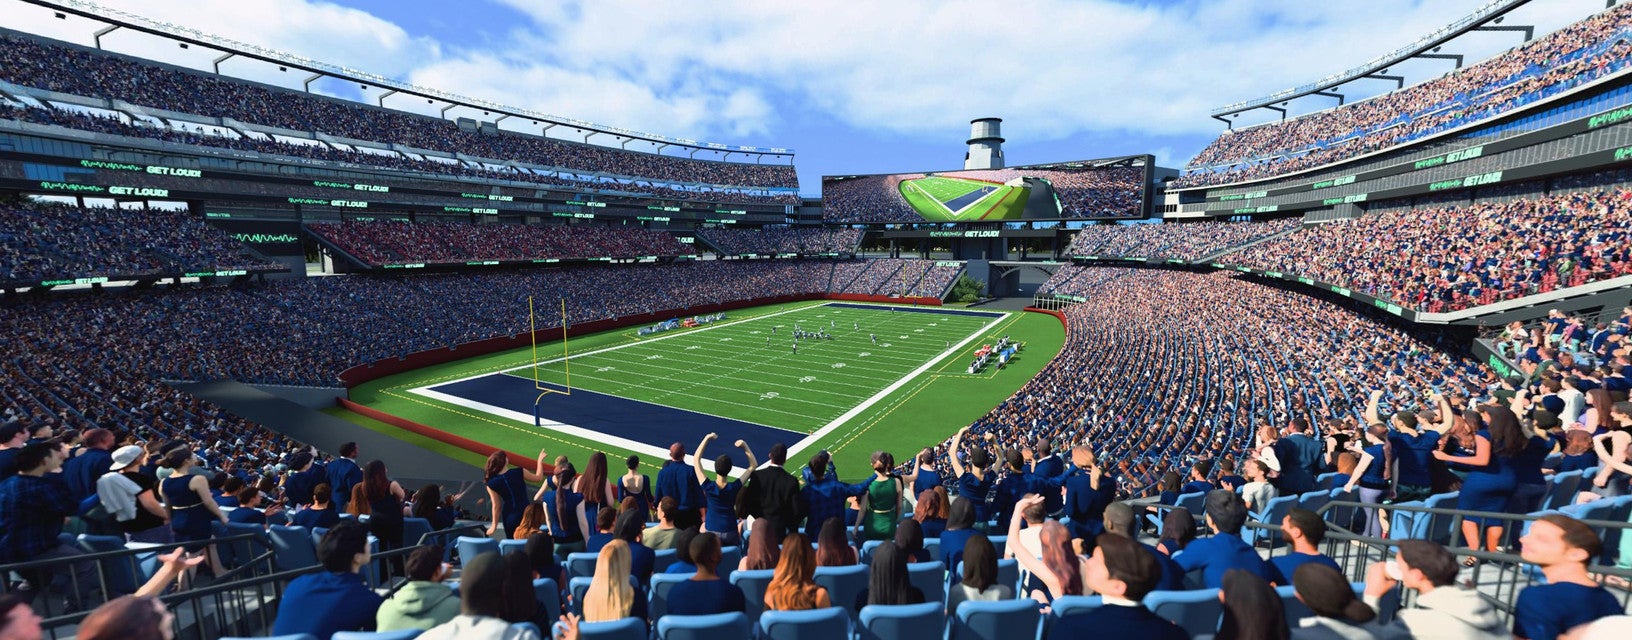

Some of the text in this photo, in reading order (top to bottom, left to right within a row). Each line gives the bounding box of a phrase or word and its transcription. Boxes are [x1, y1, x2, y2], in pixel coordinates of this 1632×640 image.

[146, 165, 202, 178] GET LOUD!
[108, 186, 168, 197] GET LOUD!
